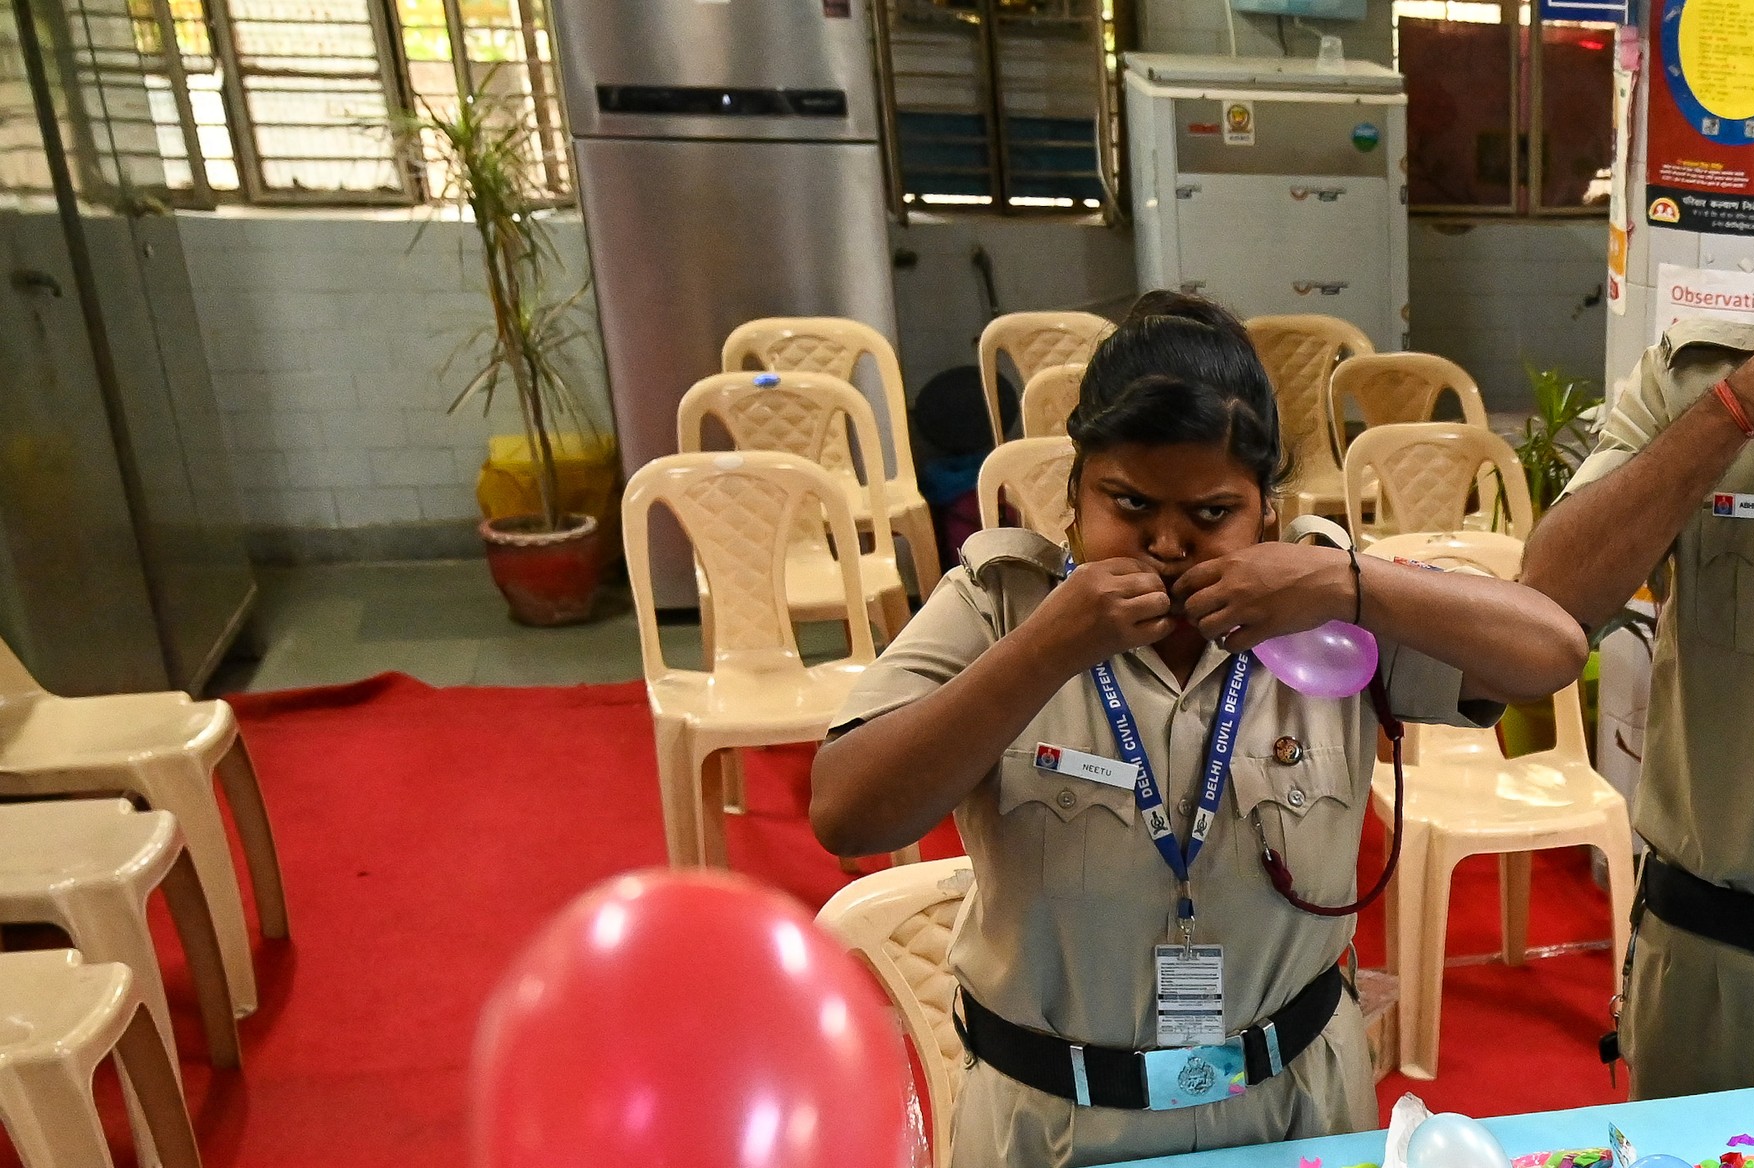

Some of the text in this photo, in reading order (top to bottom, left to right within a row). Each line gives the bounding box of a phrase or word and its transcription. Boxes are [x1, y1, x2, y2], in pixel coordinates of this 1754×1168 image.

[1116, 713, 1137, 752] CIVIL
[1204, 652, 1249, 801] DELHI CIVIL DEFENCE
[1081, 762, 1113, 777] NEETU
